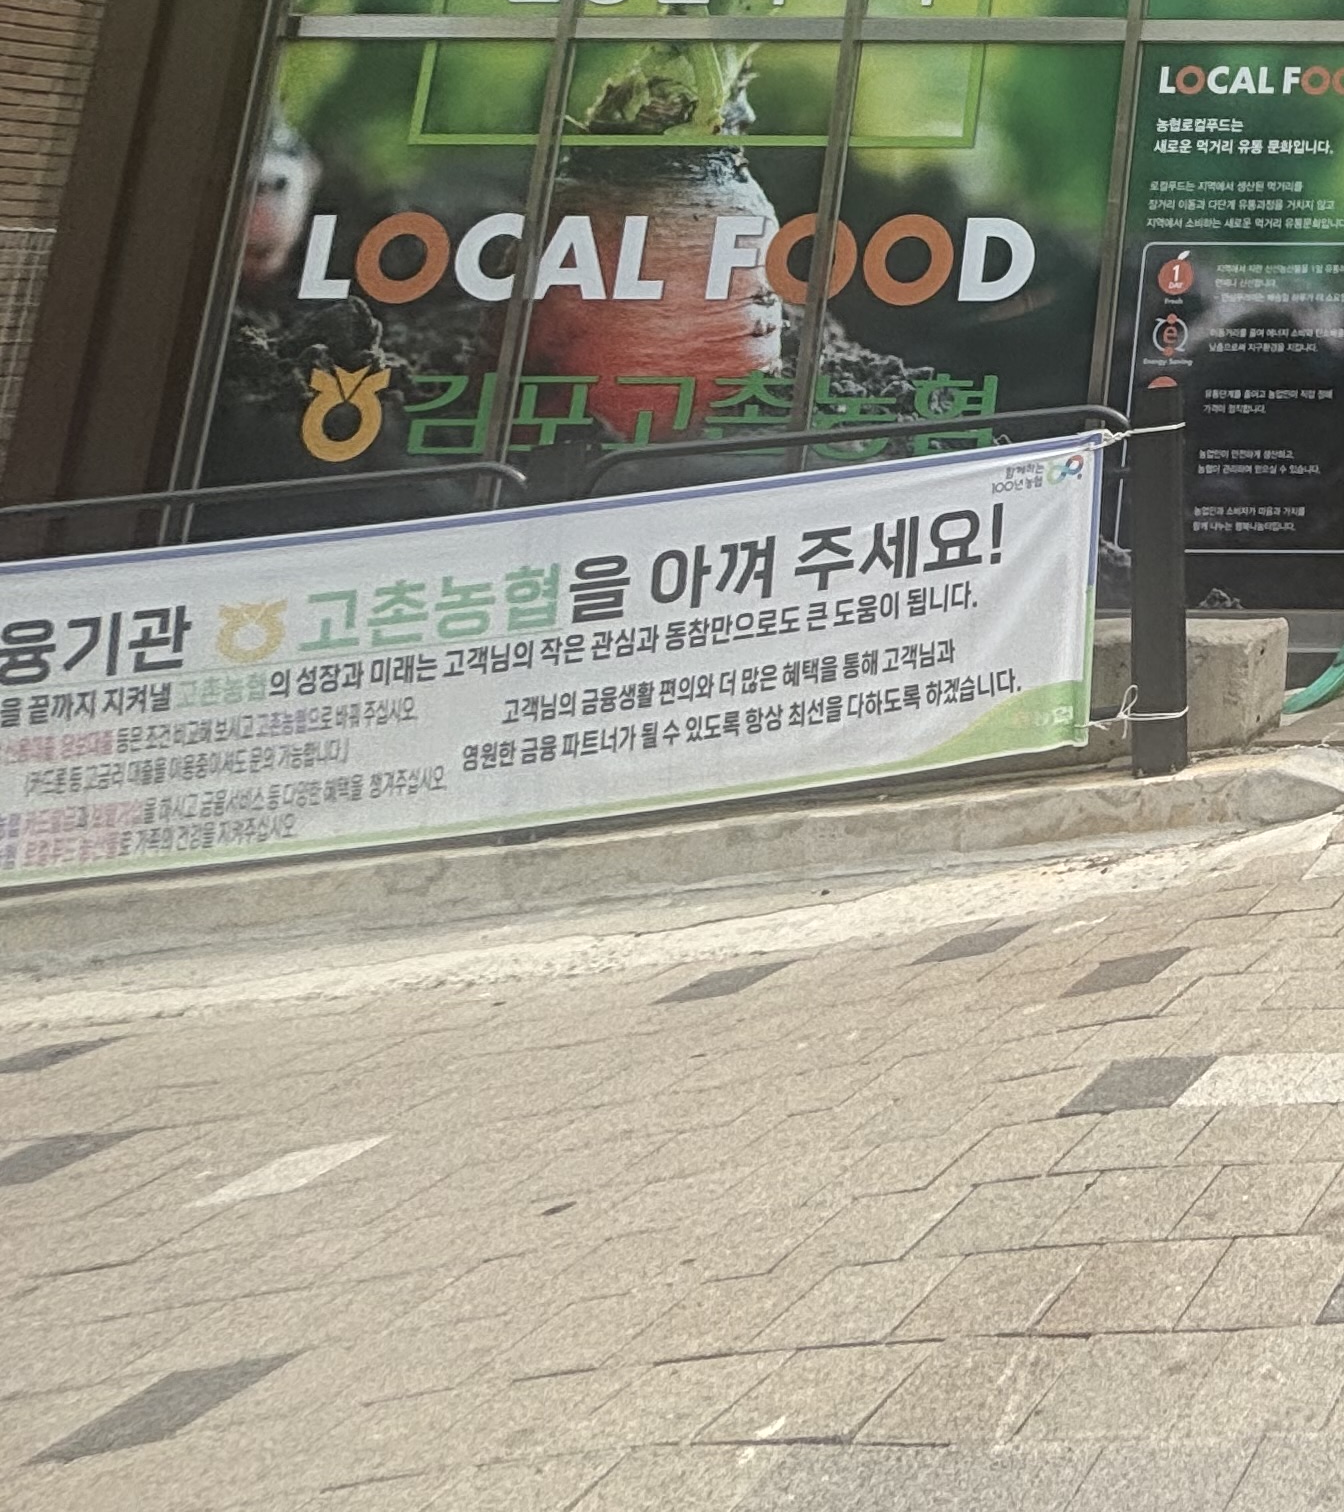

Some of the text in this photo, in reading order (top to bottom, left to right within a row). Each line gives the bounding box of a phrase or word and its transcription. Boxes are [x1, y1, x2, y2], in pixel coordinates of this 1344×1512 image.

[1158, 65, 1274, 95] LOCAL
[1153, 139, 1334, 155] 새로운 먹거리 유통 문화입니다.
[1155, 117, 1244, 134] 농협로컬푸드는
[297, 212, 1037, 306] LOCAL FOOD
[1171, 264, 1180, 282] 1
[0, 503, 1004, 686] 융기관 고촌농협을 아껴 주세요!
[28, 688, 96, 726] 끝까지
[102, 682, 172, 717] 지켜낼
[177, 669, 292, 708] 고촌농협의
[297, 661, 364, 695] 성장과
[371, 653, 438, 688] 미래는
[442, 640, 534, 678] 고객님의
[541, 633, 585, 666] 작은
[591, 622, 660, 658] 관심과
[666, 604, 801, 651] 동참만으로도
[806, 600, 828, 632] 큰
[834, 591, 900, 628] 도움이
[907, 580, 978, 618] 됩니다.
[502, 638, 956, 725] 고객님의 금융생활 편의와 더 많은 혜택을 통해 고객님과
[462, 667, 1023, 772] 영원한 금융 파트너가 될 수 있도록 항상 최선을 다하도록 하겠습니다.
